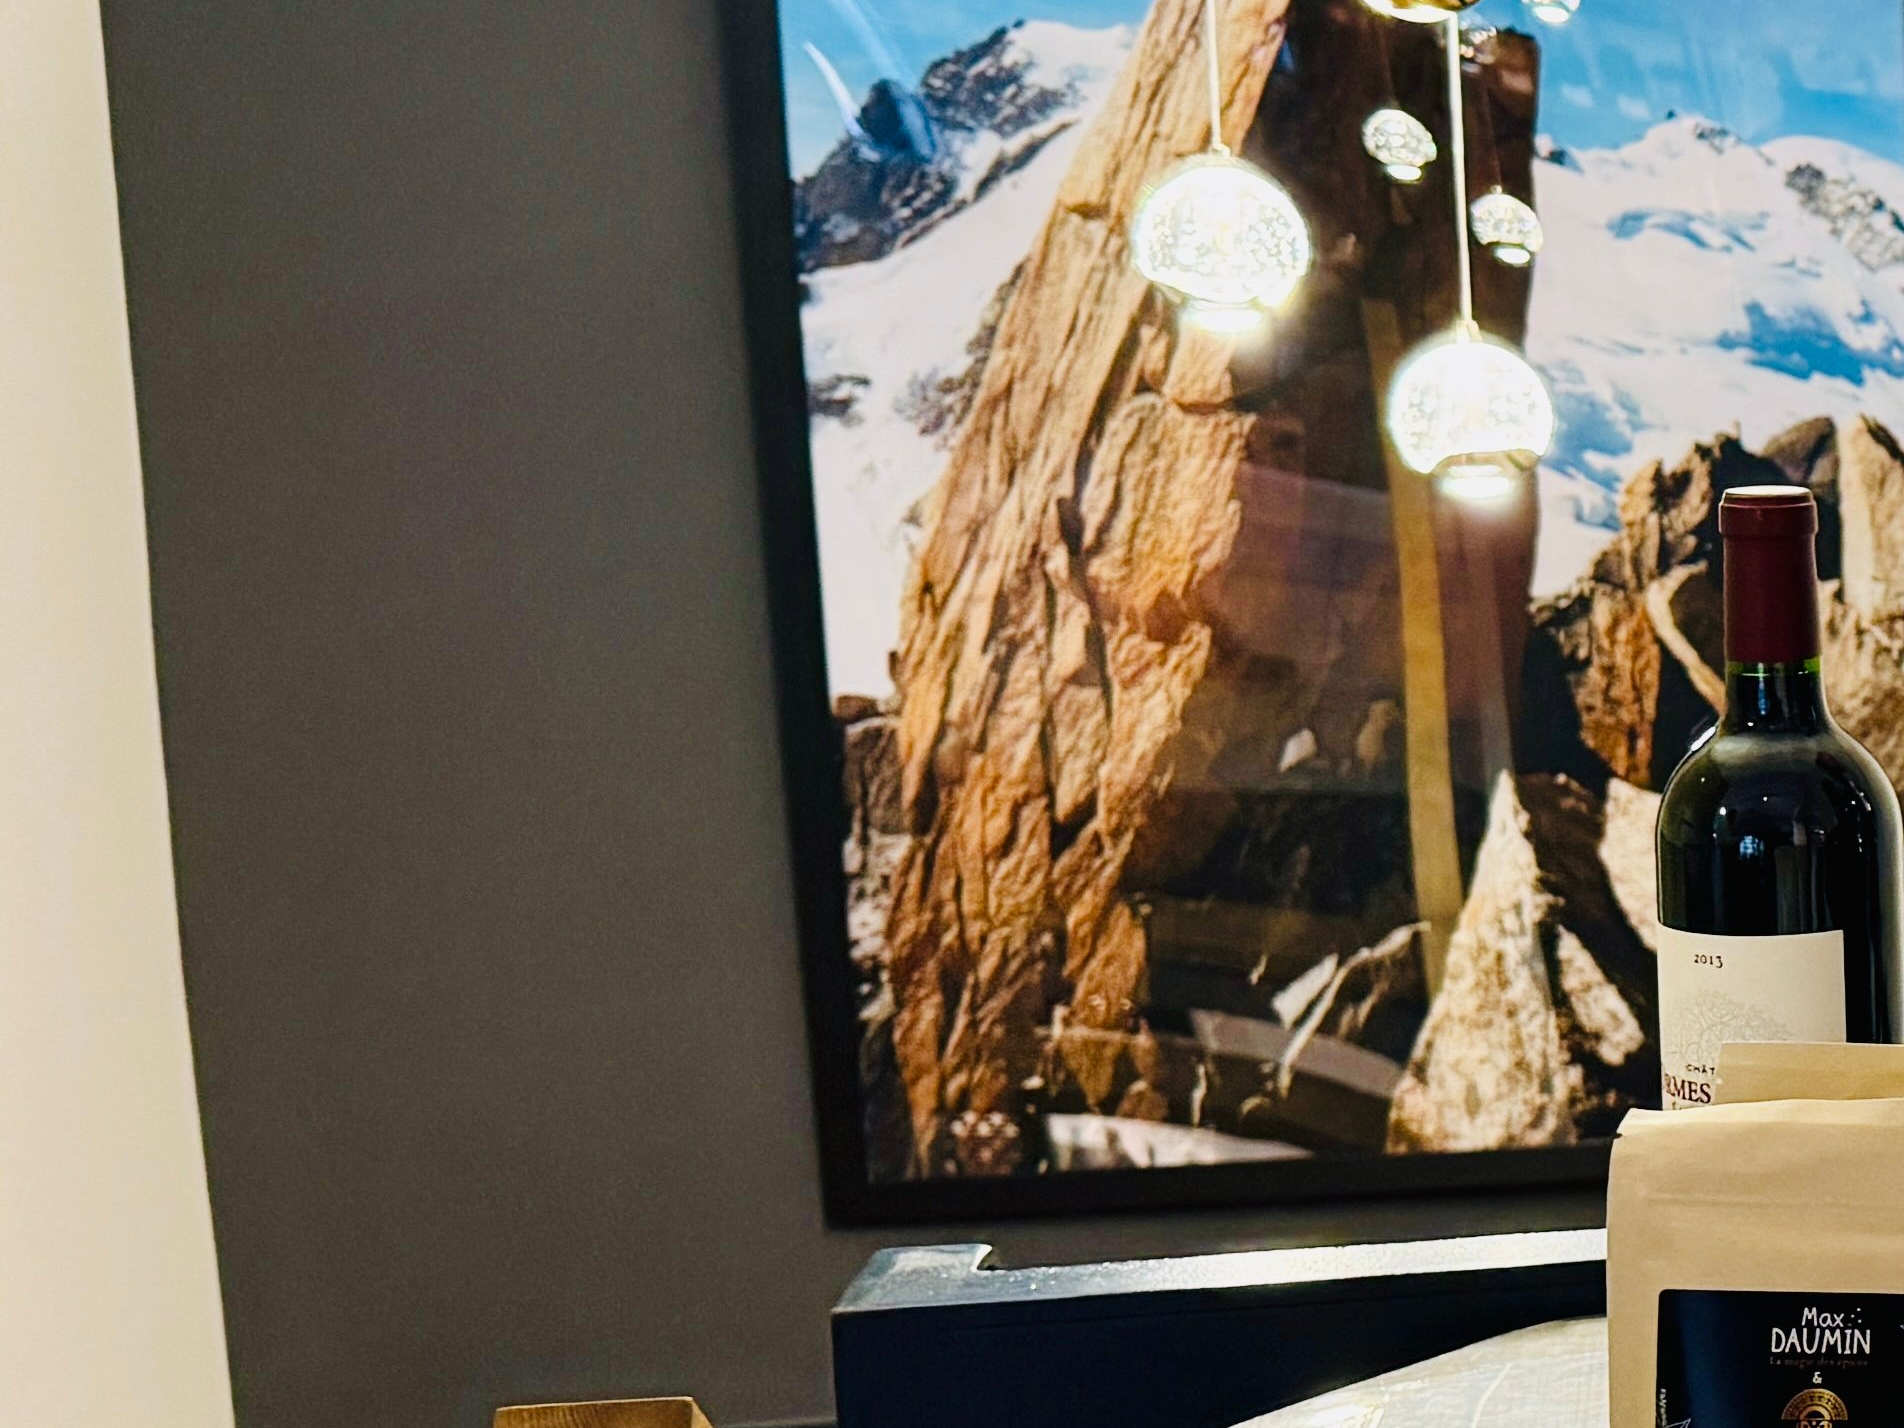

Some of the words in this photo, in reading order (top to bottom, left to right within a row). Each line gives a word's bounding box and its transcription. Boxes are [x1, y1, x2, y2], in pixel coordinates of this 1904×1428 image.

[1694, 954, 1723, 969] 2013
[1664, 1072, 1712, 1104] RMES
[1801, 1307, 1844, 1327] Max
[1771, 1328, 1870, 1355] DAUMIN
[1812, 1372, 1822, 1384] &
